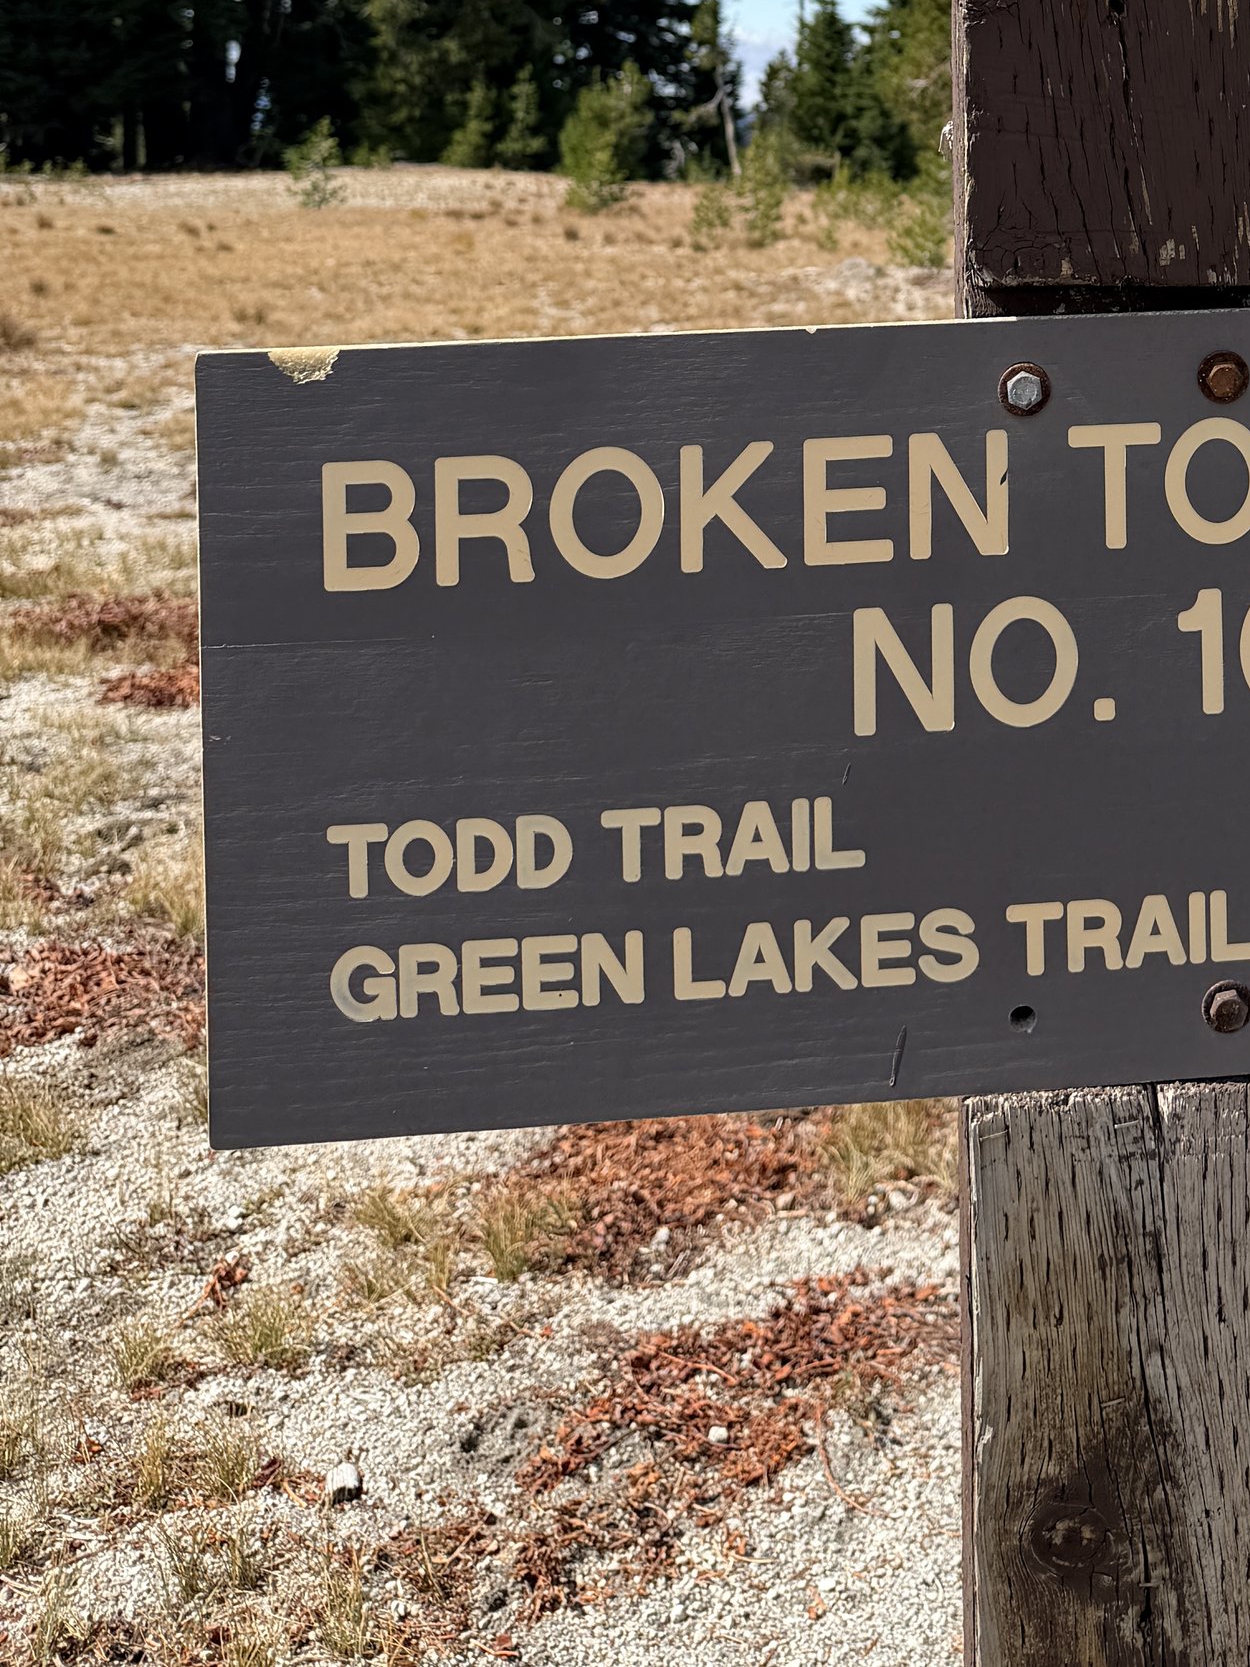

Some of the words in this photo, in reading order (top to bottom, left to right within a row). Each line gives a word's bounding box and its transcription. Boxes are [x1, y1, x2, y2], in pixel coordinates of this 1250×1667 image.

[322, 430, 1009, 591] BROKEN
[854, 596, 1115, 736] NO.
[327, 815, 572, 898] TODD
[601, 797, 865, 882] TRAIL
[330, 931, 644, 1022] GREEN
[673, 908, 979, 1000] LAKES
